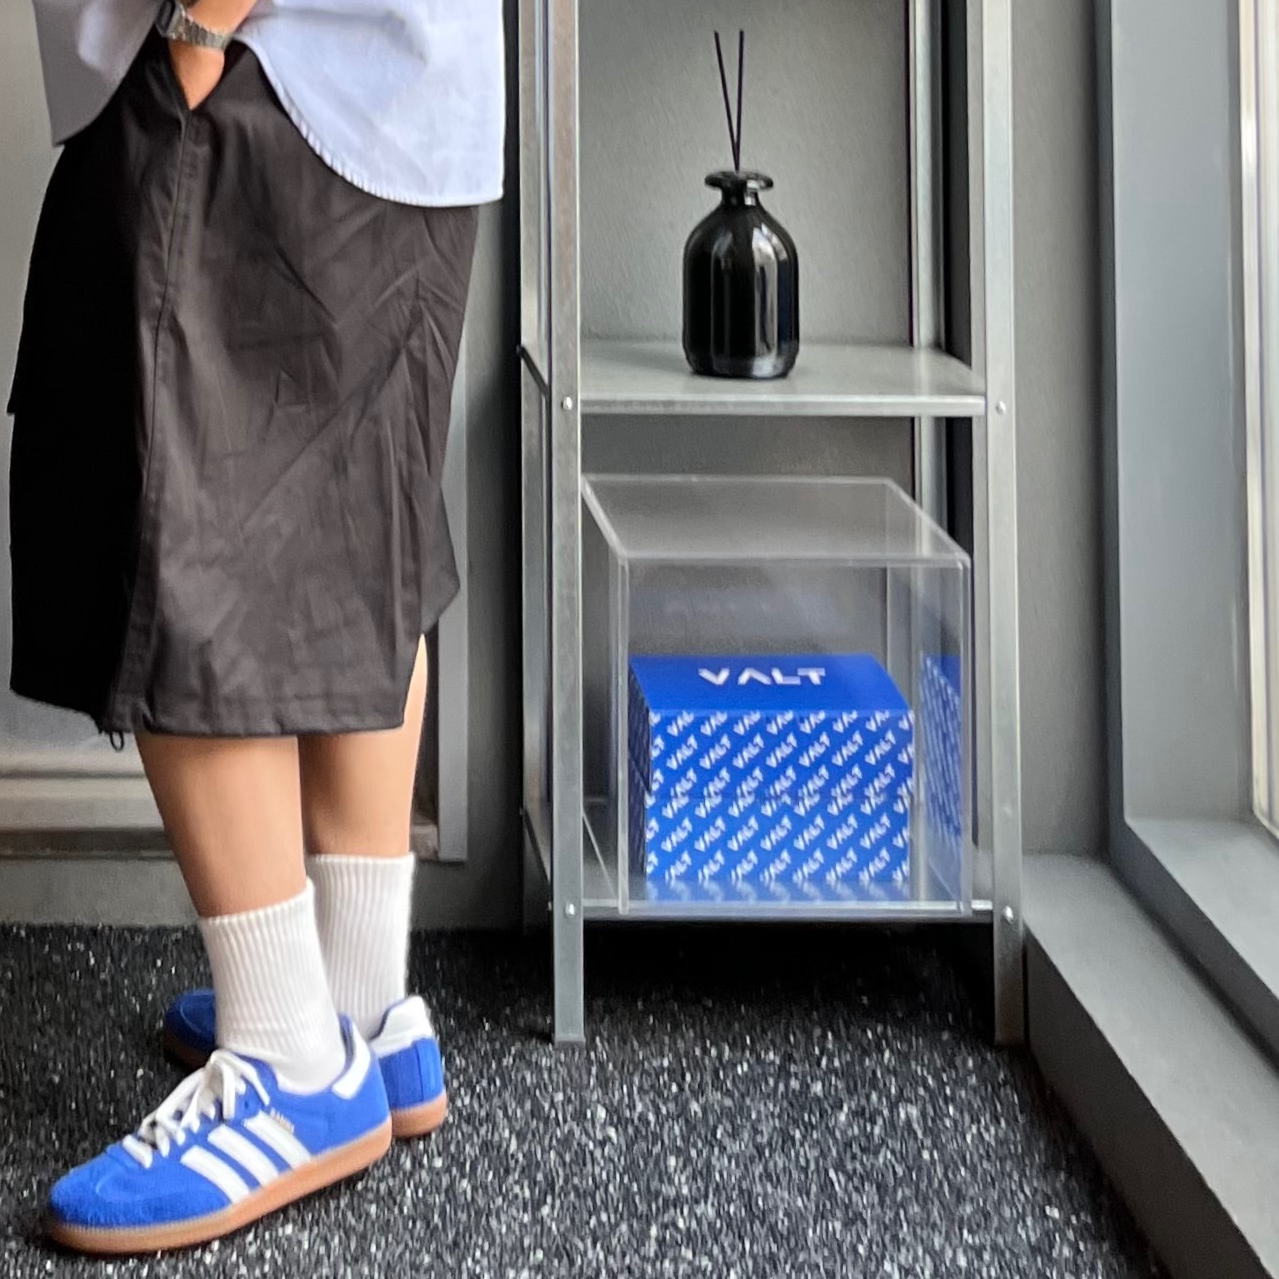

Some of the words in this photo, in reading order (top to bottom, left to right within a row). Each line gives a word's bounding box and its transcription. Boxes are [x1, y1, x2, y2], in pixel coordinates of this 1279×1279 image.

[698, 667, 826, 685] VALT
[666, 711, 695, 737] VAL
[700, 711, 728, 737] VAL
[733, 710, 761, 736] VAL
[766, 710, 794, 735] VAL
[799, 710, 826, 734] VAL
[832, 709, 858, 733] VAL
[865, 709, 890, 732] VAL
